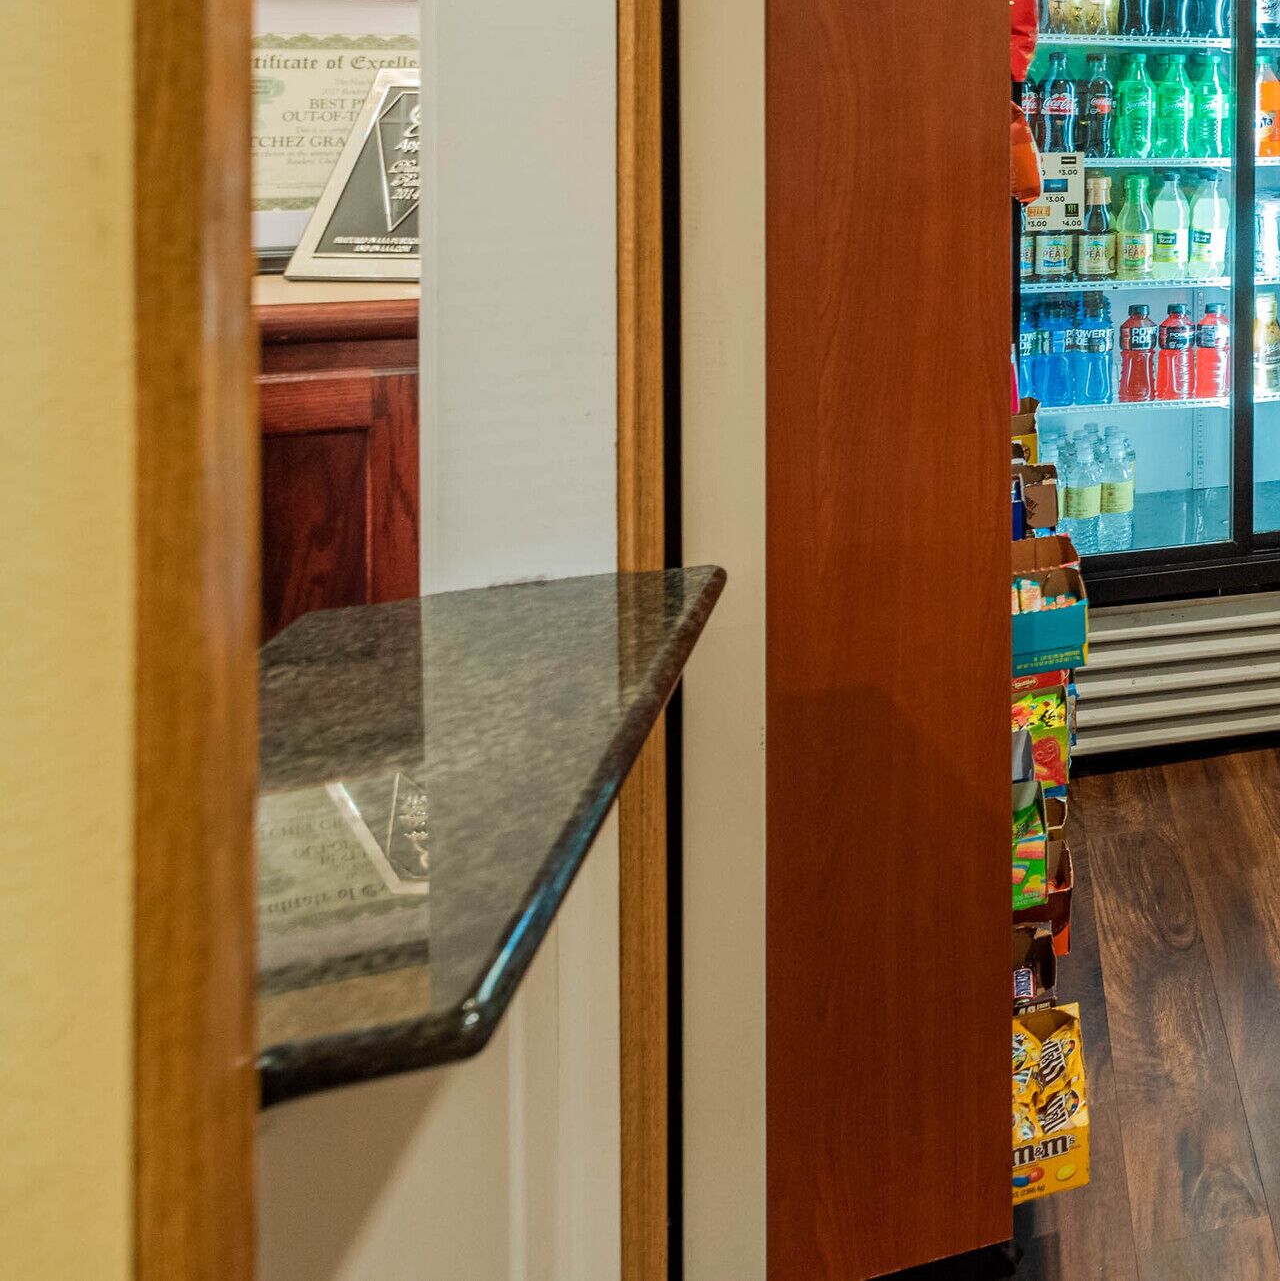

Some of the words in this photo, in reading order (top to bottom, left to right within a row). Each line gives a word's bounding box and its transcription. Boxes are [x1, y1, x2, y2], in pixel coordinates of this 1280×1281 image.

[255, 55, 319, 69] tificate
[326, 55, 345, 69] of
[351, 55, 417, 69] Excelle
[309, 98, 345, 110] BEST
[282, 110, 358, 122] OUT-OF-T
[250, 136, 306, 148] TCHEZ
[310, 136, 346, 148] GRA
